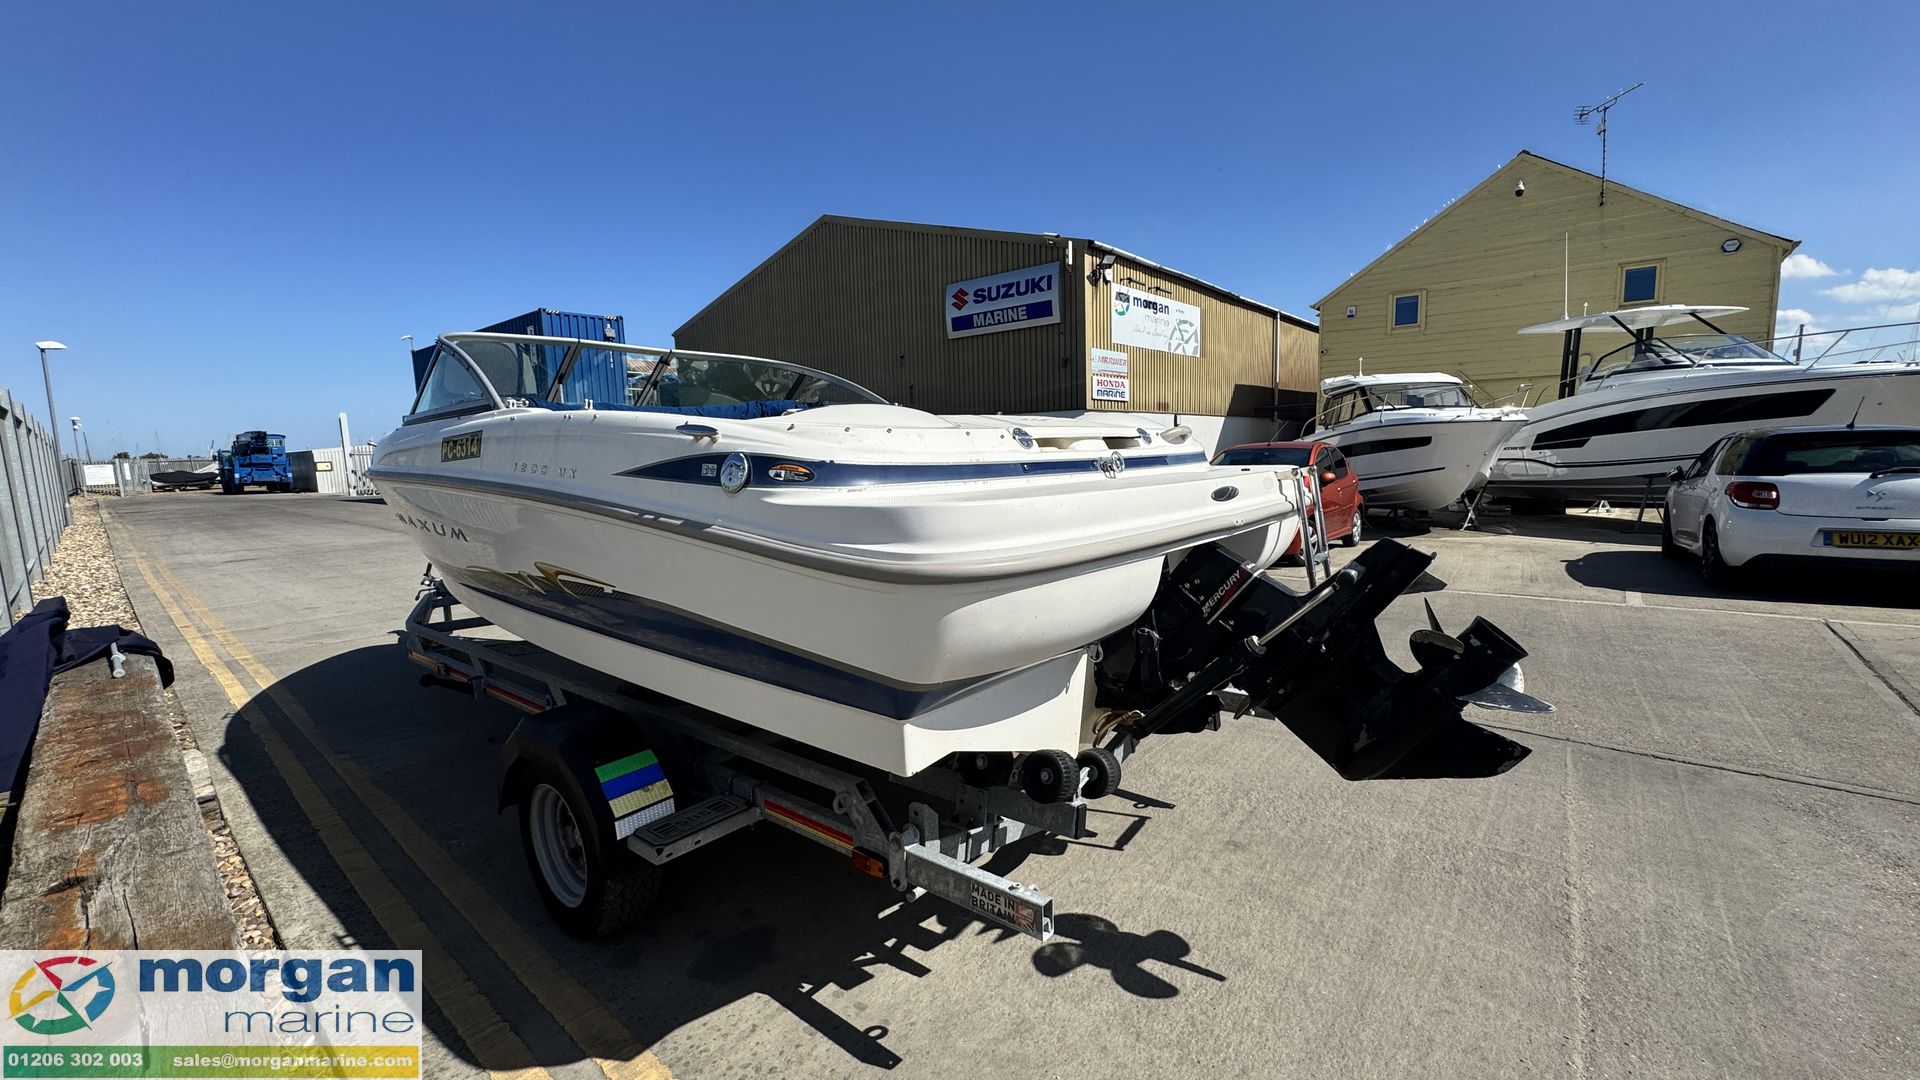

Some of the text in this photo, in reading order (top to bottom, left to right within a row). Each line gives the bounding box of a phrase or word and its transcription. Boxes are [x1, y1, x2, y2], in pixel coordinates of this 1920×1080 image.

[973, 274, 1053, 304] SUZUKI
[972, 306, 1028, 327] MARINE
[1133, 296, 1170, 315] morgan
[1144, 314, 1170, 328] marine
[1097, 379, 1126, 389] HONDA
[442, 435, 478, 460] PC-6314
[395, 512, 469, 543] MAXUM
[1838, 533, 1918, 547] WU12 XAX
[1202, 569, 1241, 618] MERCURY
[971, 881, 1015, 912] MADE IN
[970, 895, 1015, 925] BRITAIN
